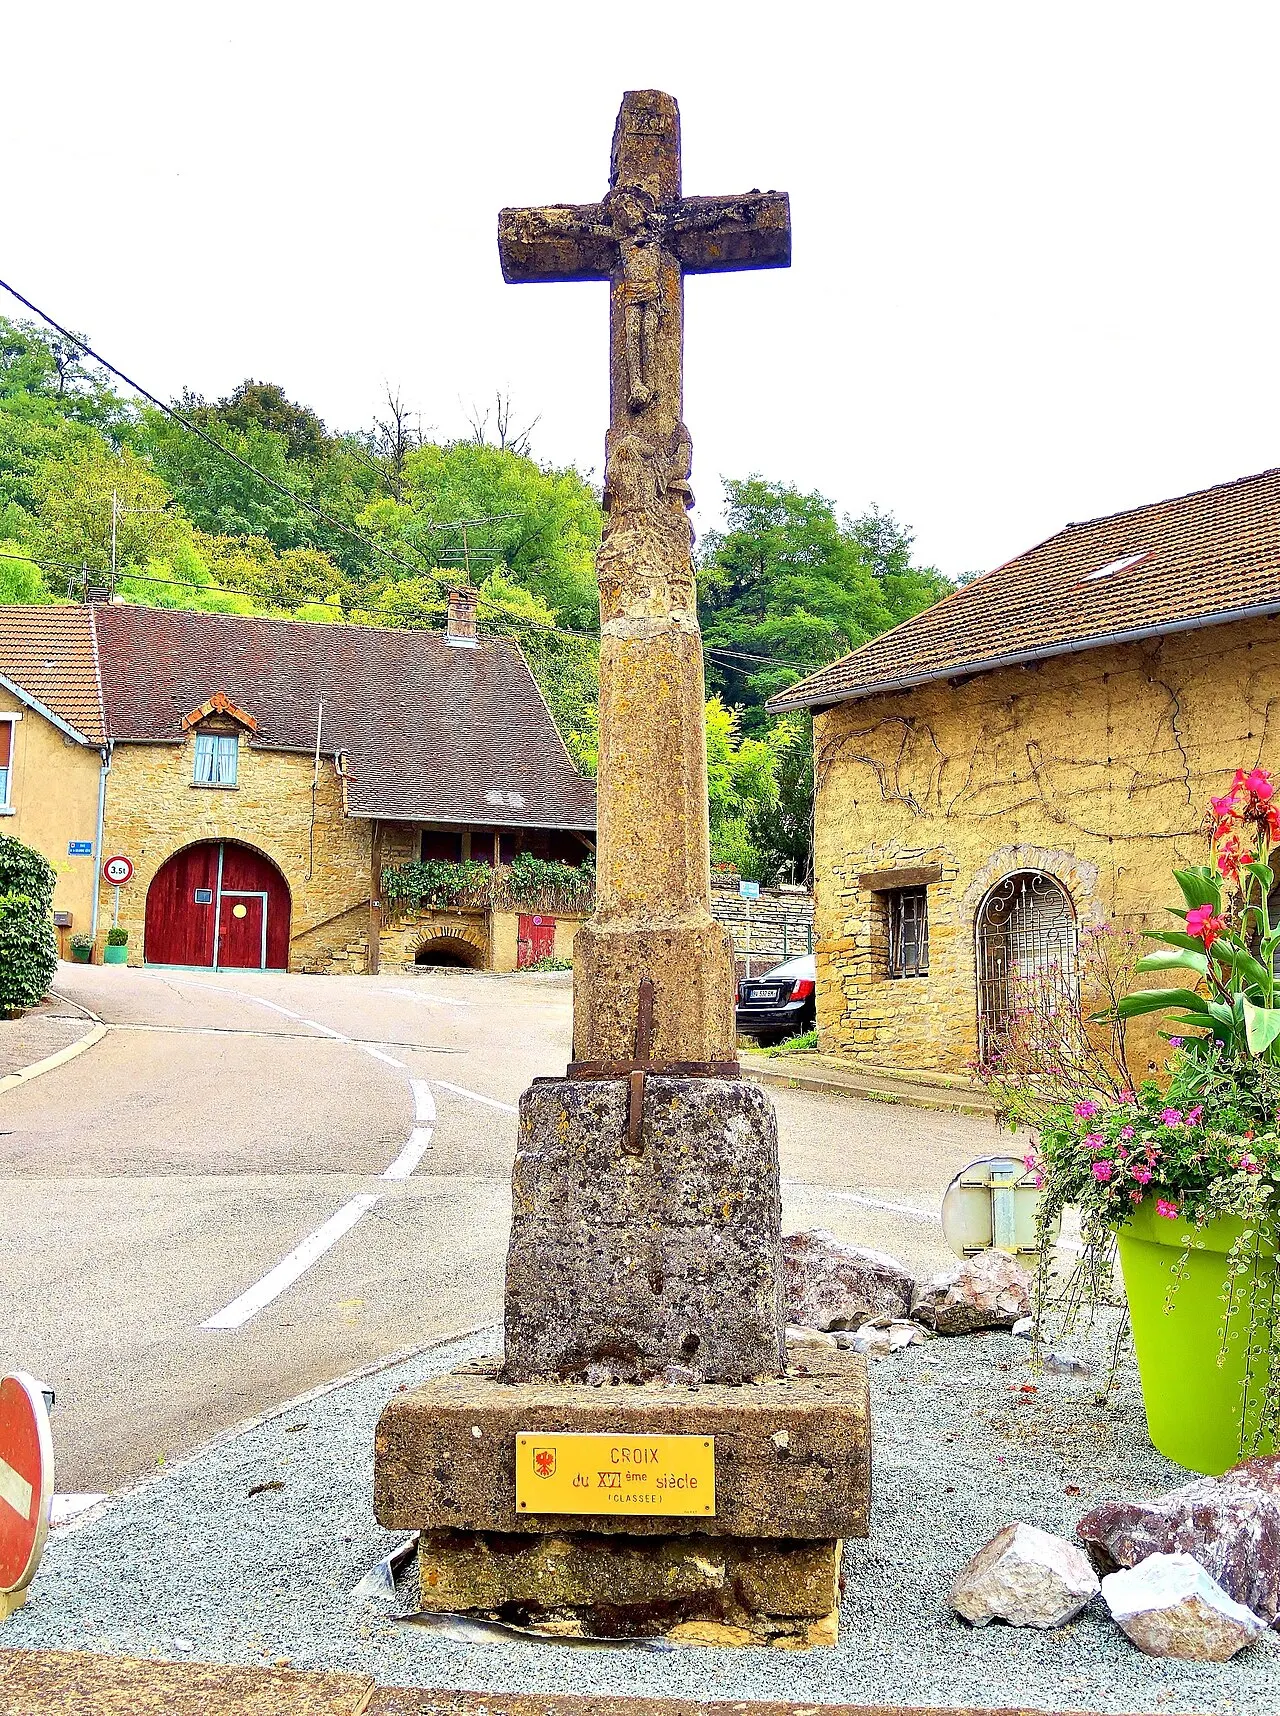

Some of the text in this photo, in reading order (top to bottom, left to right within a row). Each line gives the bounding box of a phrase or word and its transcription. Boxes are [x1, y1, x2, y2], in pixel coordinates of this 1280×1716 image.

[610, 1447, 659, 1464] CROIX
[572, 1472, 589, 1487] du
[625, 1470, 647, 1481] ème
[656, 1473, 698, 1489] siècle
